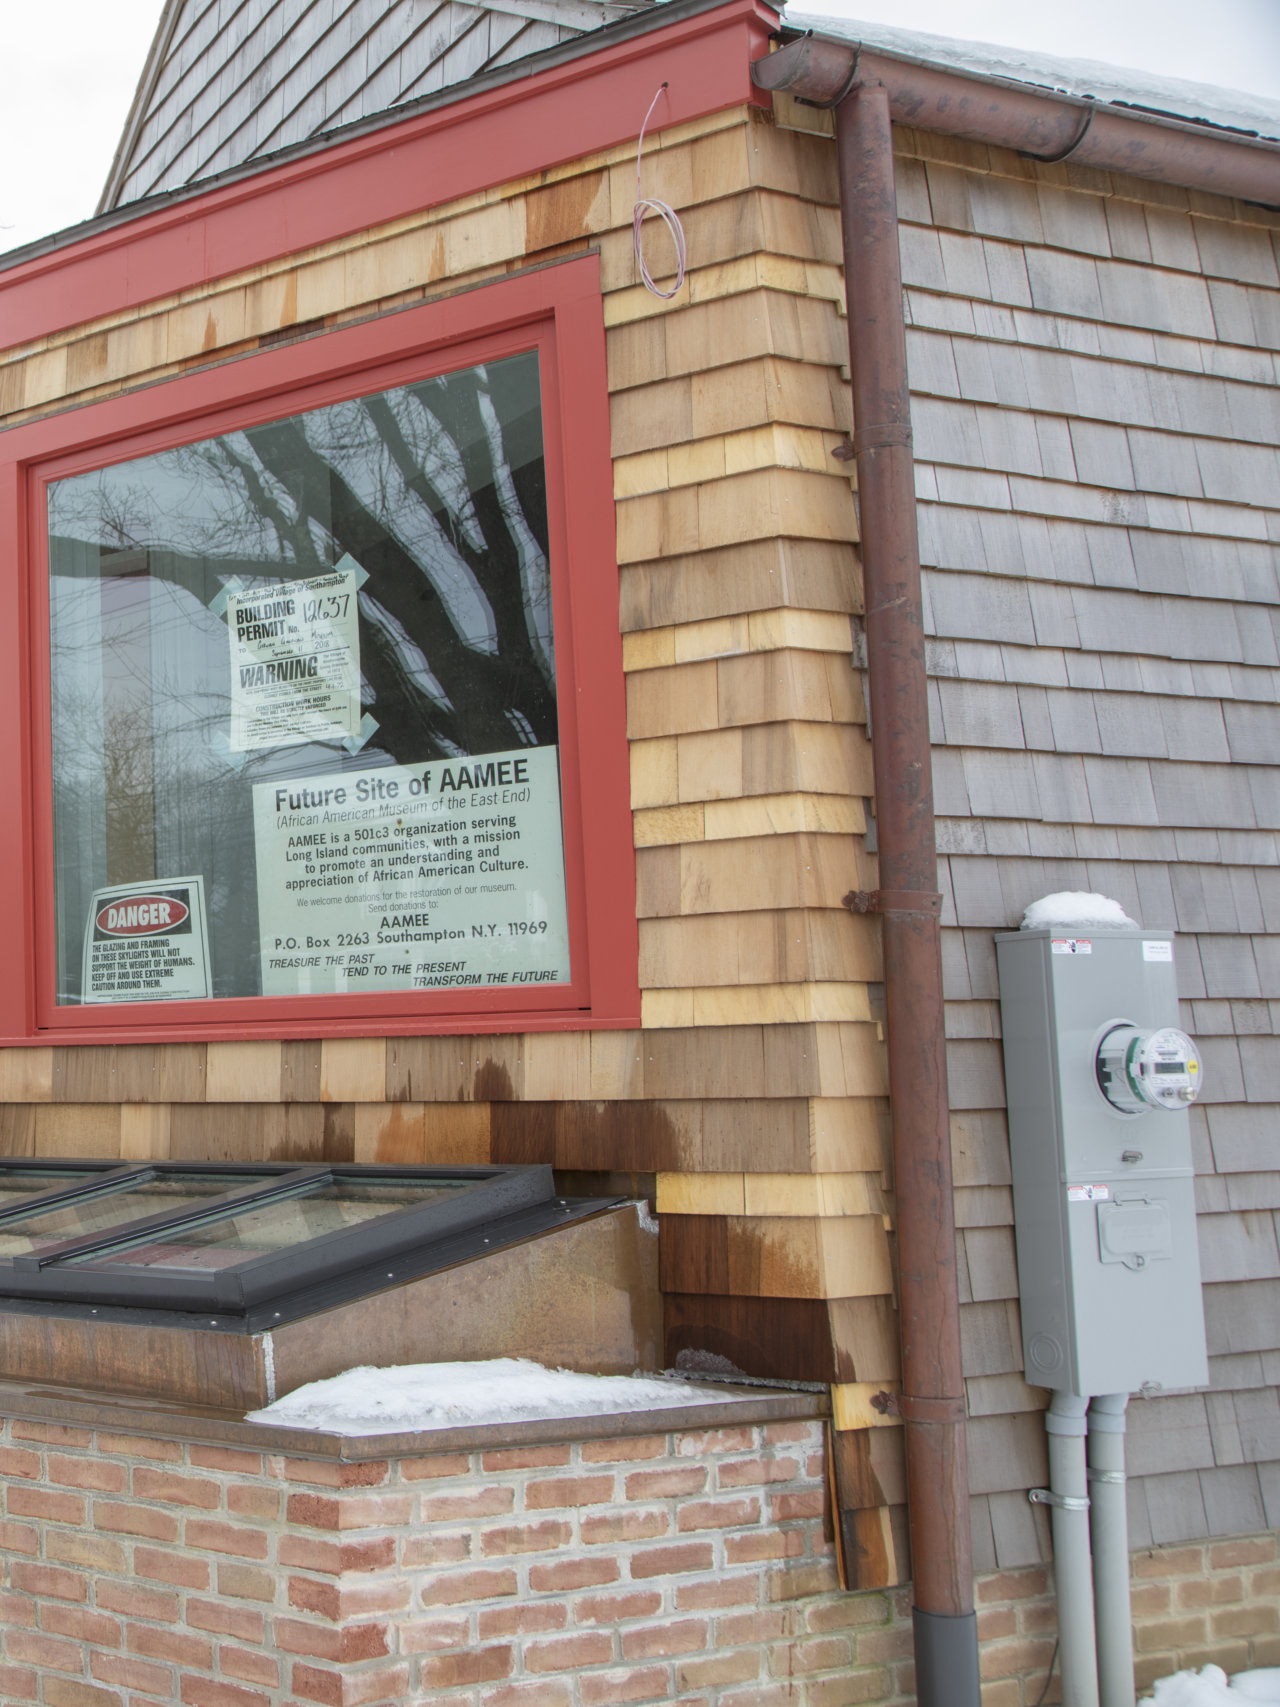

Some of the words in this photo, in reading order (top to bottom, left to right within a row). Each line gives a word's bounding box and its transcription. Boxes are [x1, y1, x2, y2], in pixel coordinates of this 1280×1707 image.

[305, 578, 346, 590] Southampton
[236, 599, 296, 625] BUILDING
[303, 593, 350, 624] 12637
[237, 619, 286, 643] PERMIT
[239, 655, 319, 689] WARNING
[255, 701, 294, 713] CONSTRUCTION
[312, 694, 331, 703] HOURS
[275, 787, 347, 812] Future
[355, 777, 399, 802] Site
[409, 770, 431, 795] of
[440, 758, 530, 792] AAMEE
[277, 814, 319, 830] (African
[322, 808, 375, 824] American
[379, 802, 427, 818] Museum
[431, 797, 444, 812] of
[448, 796, 466, 810] the
[471, 792, 498, 807] East
[502, 787, 531, 803] End)
[288, 833, 327, 848] AAMEE
[330, 832, 340, 844] is
[343, 833, 350, 843] a
[354, 826, 389, 841] 501c3
[393, 820, 467, 838] organization
[471, 815, 517, 829] serving
[286, 850, 312, 863] Long
[316, 845, 348, 859] Island
[352, 838, 429, 855] communities,
[433, 834, 458, 847] with
[462, 836, 469, 845] a
[474, 830, 521, 844] mission
[305, 864, 316, 874] to
[320, 859, 366, 875] promote
[370, 858, 384, 868] an
[388, 849, 473, 866] understanding
[477, 845, 500, 858] and
[286, 875, 354, 891] appreciation
[358, 872, 369, 883] of
[373, 869, 414, 882] African
[418, 863, 475, 878] American
[479, 859, 529, 873] Culture.
[297, 898, 309, 907] We
[310, 896, 343, 906] welcome
[344, 892, 380, 904] donations
[382, 891, 393, 900] for
[395, 890, 408, 899] the
[410, 886, 451, 899] restoration
[453, 885, 462, 895] of
[464, 886, 478, 894] our
[480, 883, 517, 893] museum.
[368, 903, 387, 912] Send
[389, 900, 426, 911] donations
[428, 900, 439, 909] to:
[107, 902, 172, 929] DANGER
[380, 914, 429, 929] AAMEE
[92, 944, 102, 953] THE
[102, 942, 126, 952] GLAZING
[127, 940, 140, 950] AND
[140, 938, 170, 949] FRAMING
[275, 937, 301, 950] P.O.
[306, 936, 330, 948] Box
[337, 931, 370, 947] 2263
[377, 929, 465, 944] Southampton
[471, 923, 502, 938] N.Y.
[507, 921, 548, 936] 11969
[91, 962, 116, 973] SUPPORT
[117, 961, 128, 970] THE
[128, 959, 153, 970] WEIGHT
[153, 959, 161, 968] OF
[163, 957, 196, 967] HUMANS.
[92, 954, 100, 963] ON
[100, 952, 117, 962] THESE
[118, 949, 150, 961] SKYLIGHTS
[150, 948, 167, 959] WILL
[167, 947, 181, 957] NOT
[269, 956, 321, 969] TREASURE
[325, 955, 345, 966] THE
[348, 953, 376, 965] PAST
[91, 972, 106, 982] KEEP
[106, 971, 116, 981] OFF
[117, 970, 130, 980] AND
[131, 969, 143, 979] USE
[144, 968, 174, 978] EXTREME
[341, 966, 369, 977] TEND
[373, 965, 387, 976] TO
[391, 963, 412, 975] THE
[416, 961, 467, 974] PRESENT
[413, 973, 482, 987] TRANSFORM
[486, 972, 509, 984] THE
[511, 970, 559, 983] FUTURE
[91, 982, 116, 992] CAUTION
[116, 980, 141, 990] AROUND
[142, 979, 163, 988] THEM.
